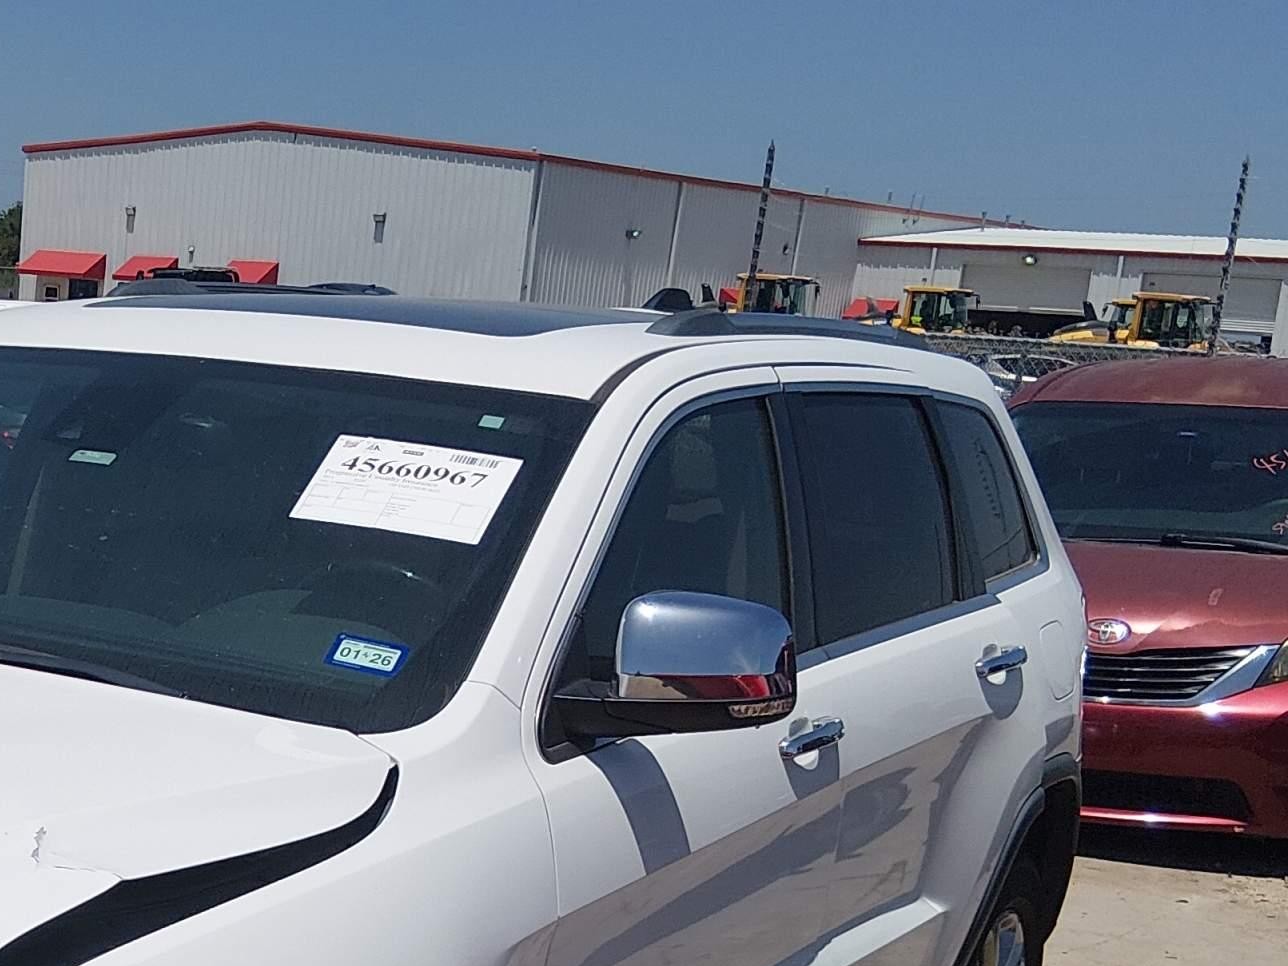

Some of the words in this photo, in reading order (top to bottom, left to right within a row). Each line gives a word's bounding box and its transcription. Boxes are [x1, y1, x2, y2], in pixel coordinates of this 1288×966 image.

[340, 455, 488, 489] 45660967
[1252, 449, 1288, 475] 45
[339, 646, 362, 660] 01
[369, 653, 394, 666] 26
